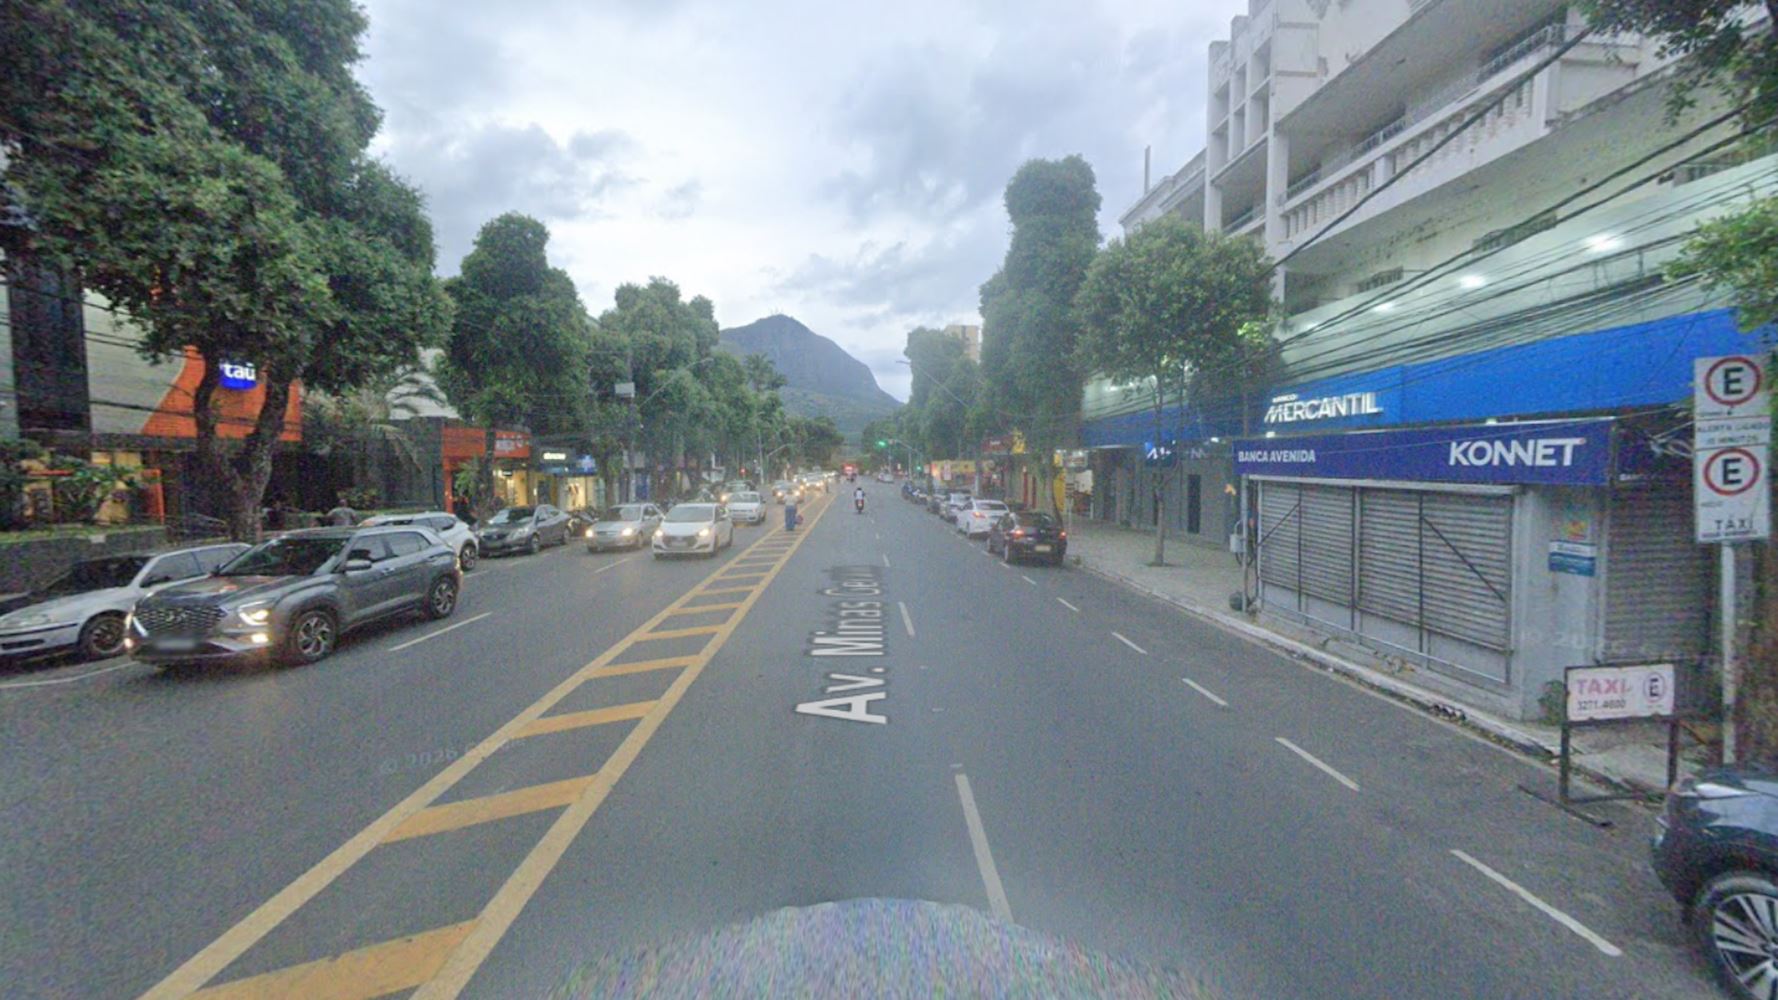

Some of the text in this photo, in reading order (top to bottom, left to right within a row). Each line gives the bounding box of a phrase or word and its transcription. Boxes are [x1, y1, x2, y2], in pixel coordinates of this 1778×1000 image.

[1723, 367, 1743, 395] E
[1264, 392, 1384, 423] MERCANTIL
[1238, 449, 1316, 463] BANCA AVENIDA
[1449, 437, 1586, 466] KONNET
[1722, 458, 1742, 485] E
[1577, 679, 1627, 695] TAXI
[1649, 677, 1660, 697] E
